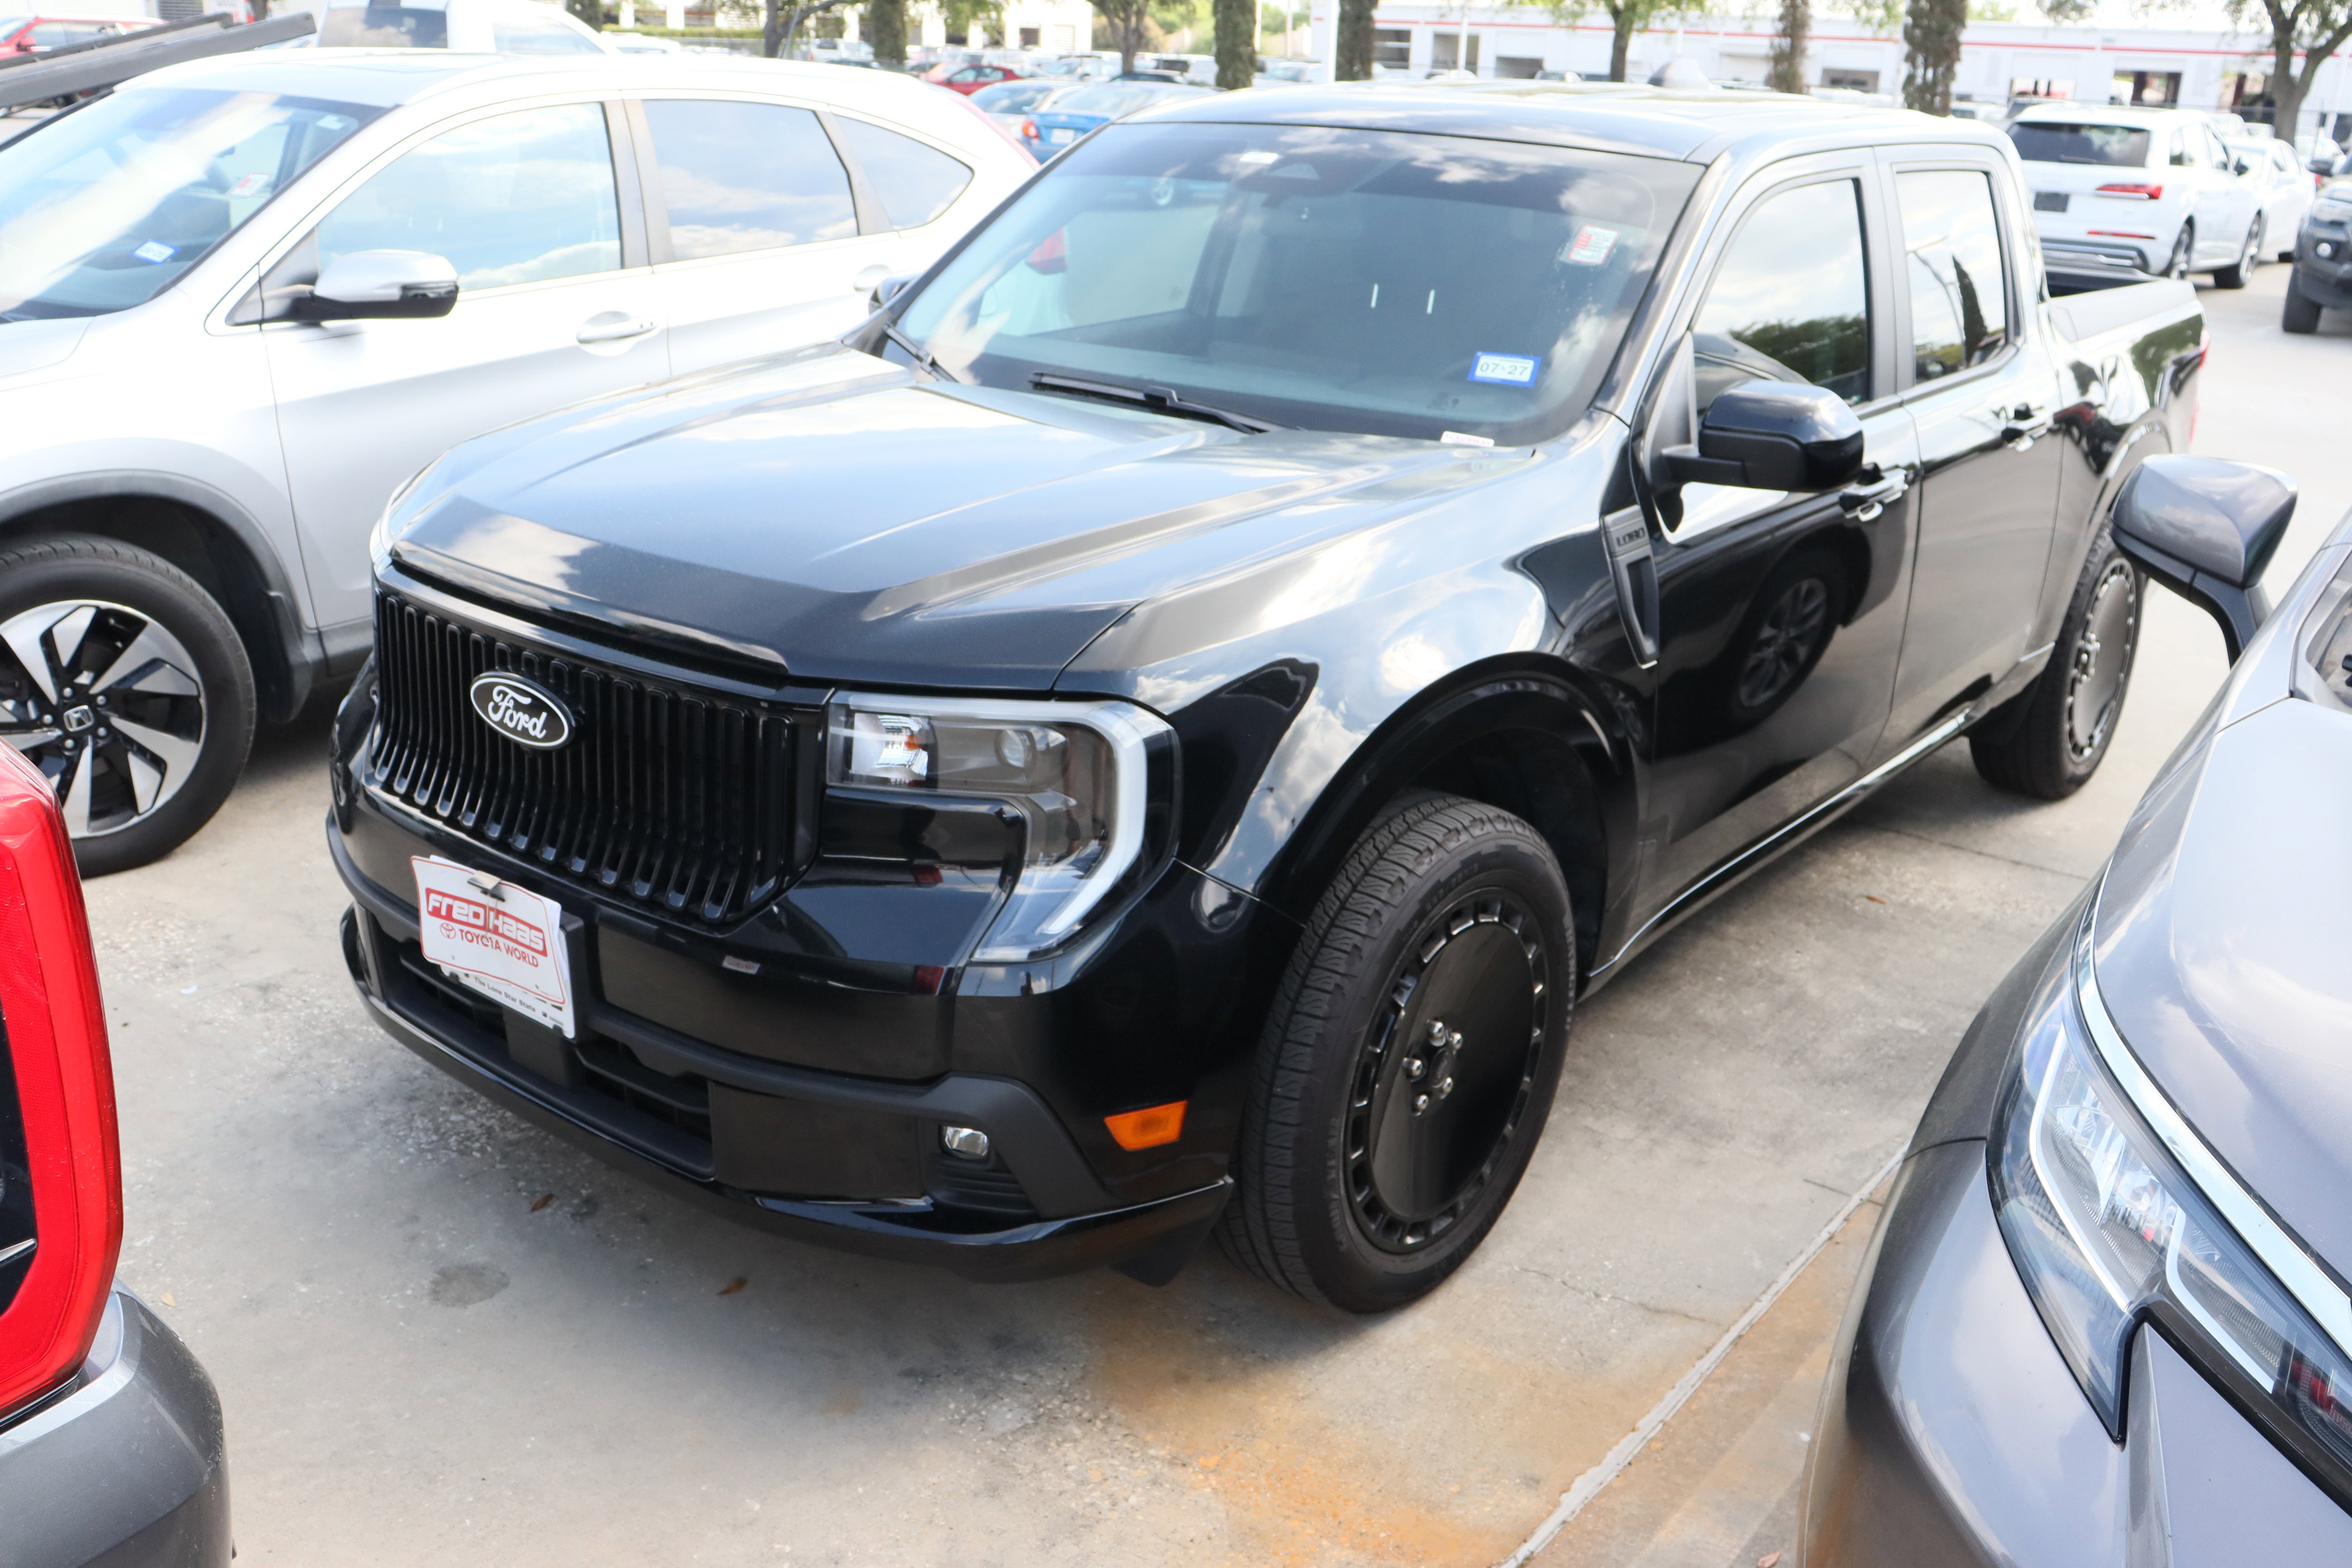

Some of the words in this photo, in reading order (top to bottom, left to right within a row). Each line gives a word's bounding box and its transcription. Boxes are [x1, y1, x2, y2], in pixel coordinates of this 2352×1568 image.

[488, 685, 548, 739] Ford
[459, 929, 502, 950] TOYOTA
[503, 943, 538, 968] WORLD
[474, 976, 486, 987] The
[487, 984, 502, 995] Lone
[504, 992, 517, 1003] Star
[518, 999, 536, 1012] State
